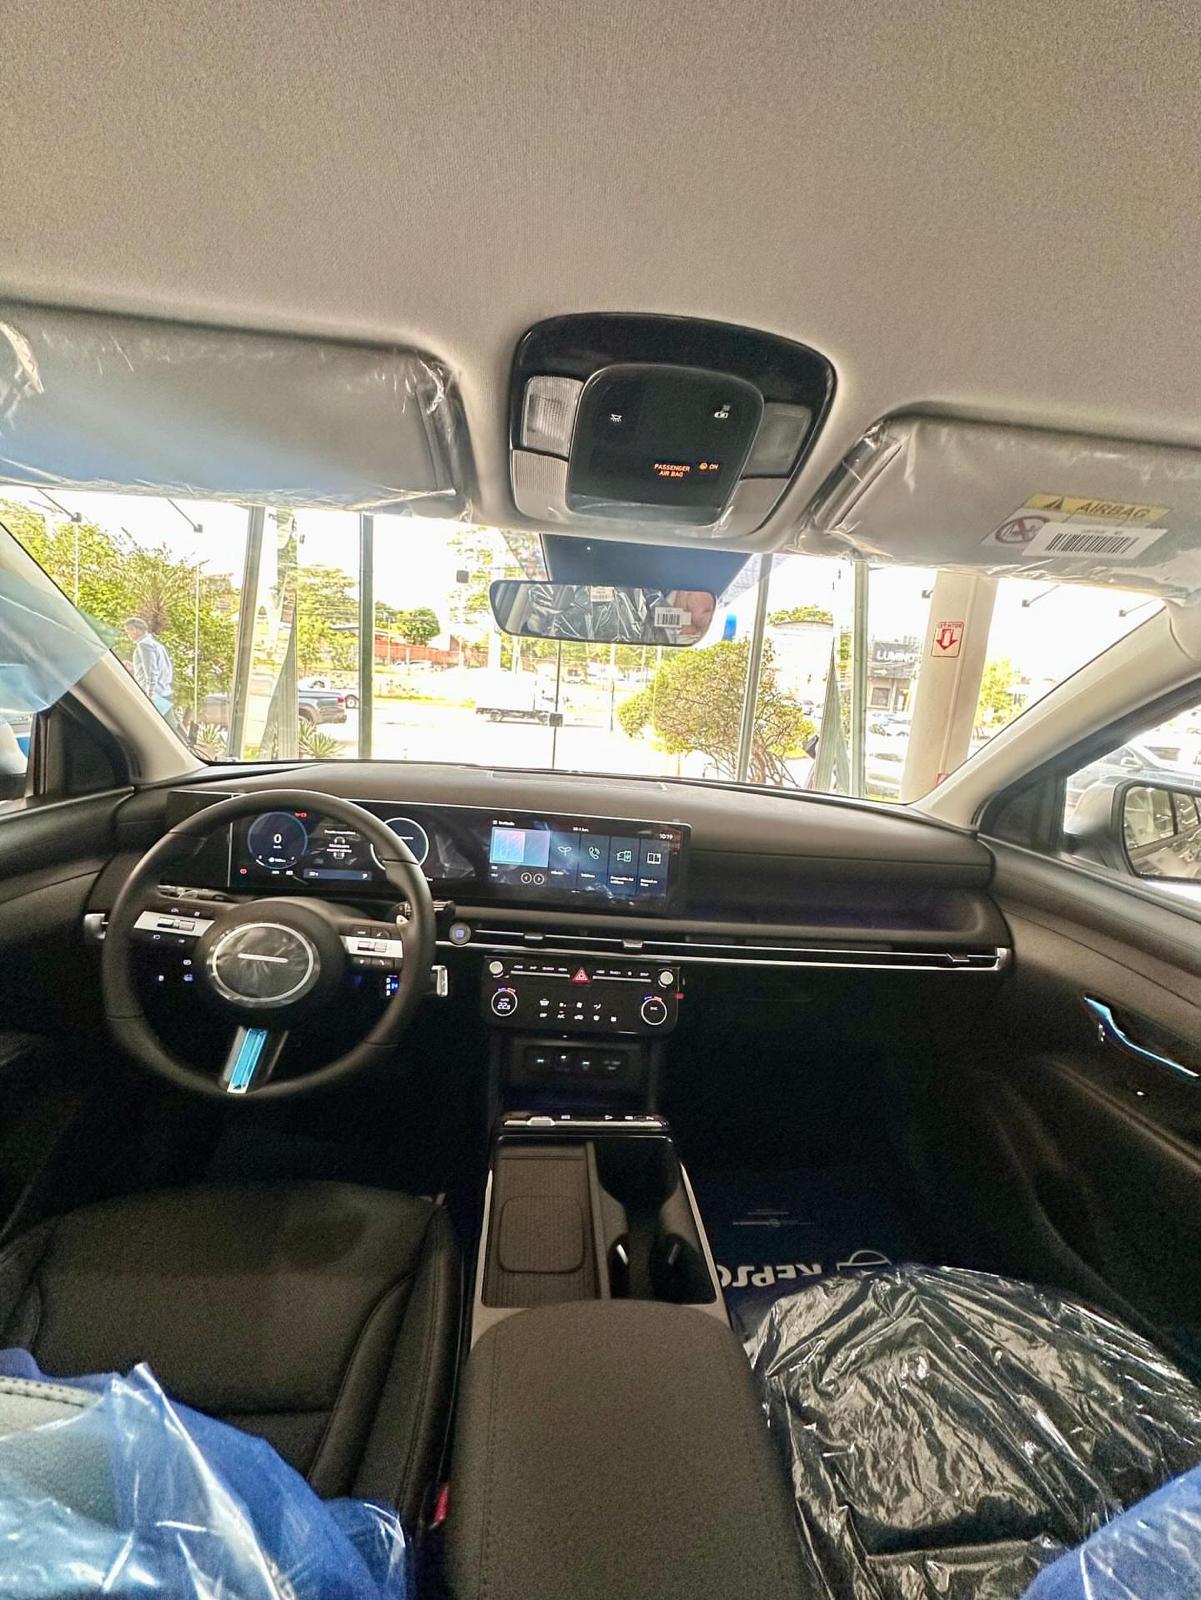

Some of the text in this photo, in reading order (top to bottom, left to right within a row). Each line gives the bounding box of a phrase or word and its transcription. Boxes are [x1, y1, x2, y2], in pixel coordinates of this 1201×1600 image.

[654, 463, 691, 473] PASSENGER
[1077, 501, 1151, 519] AIRBAG
[273, 833, 282, 844] 0
